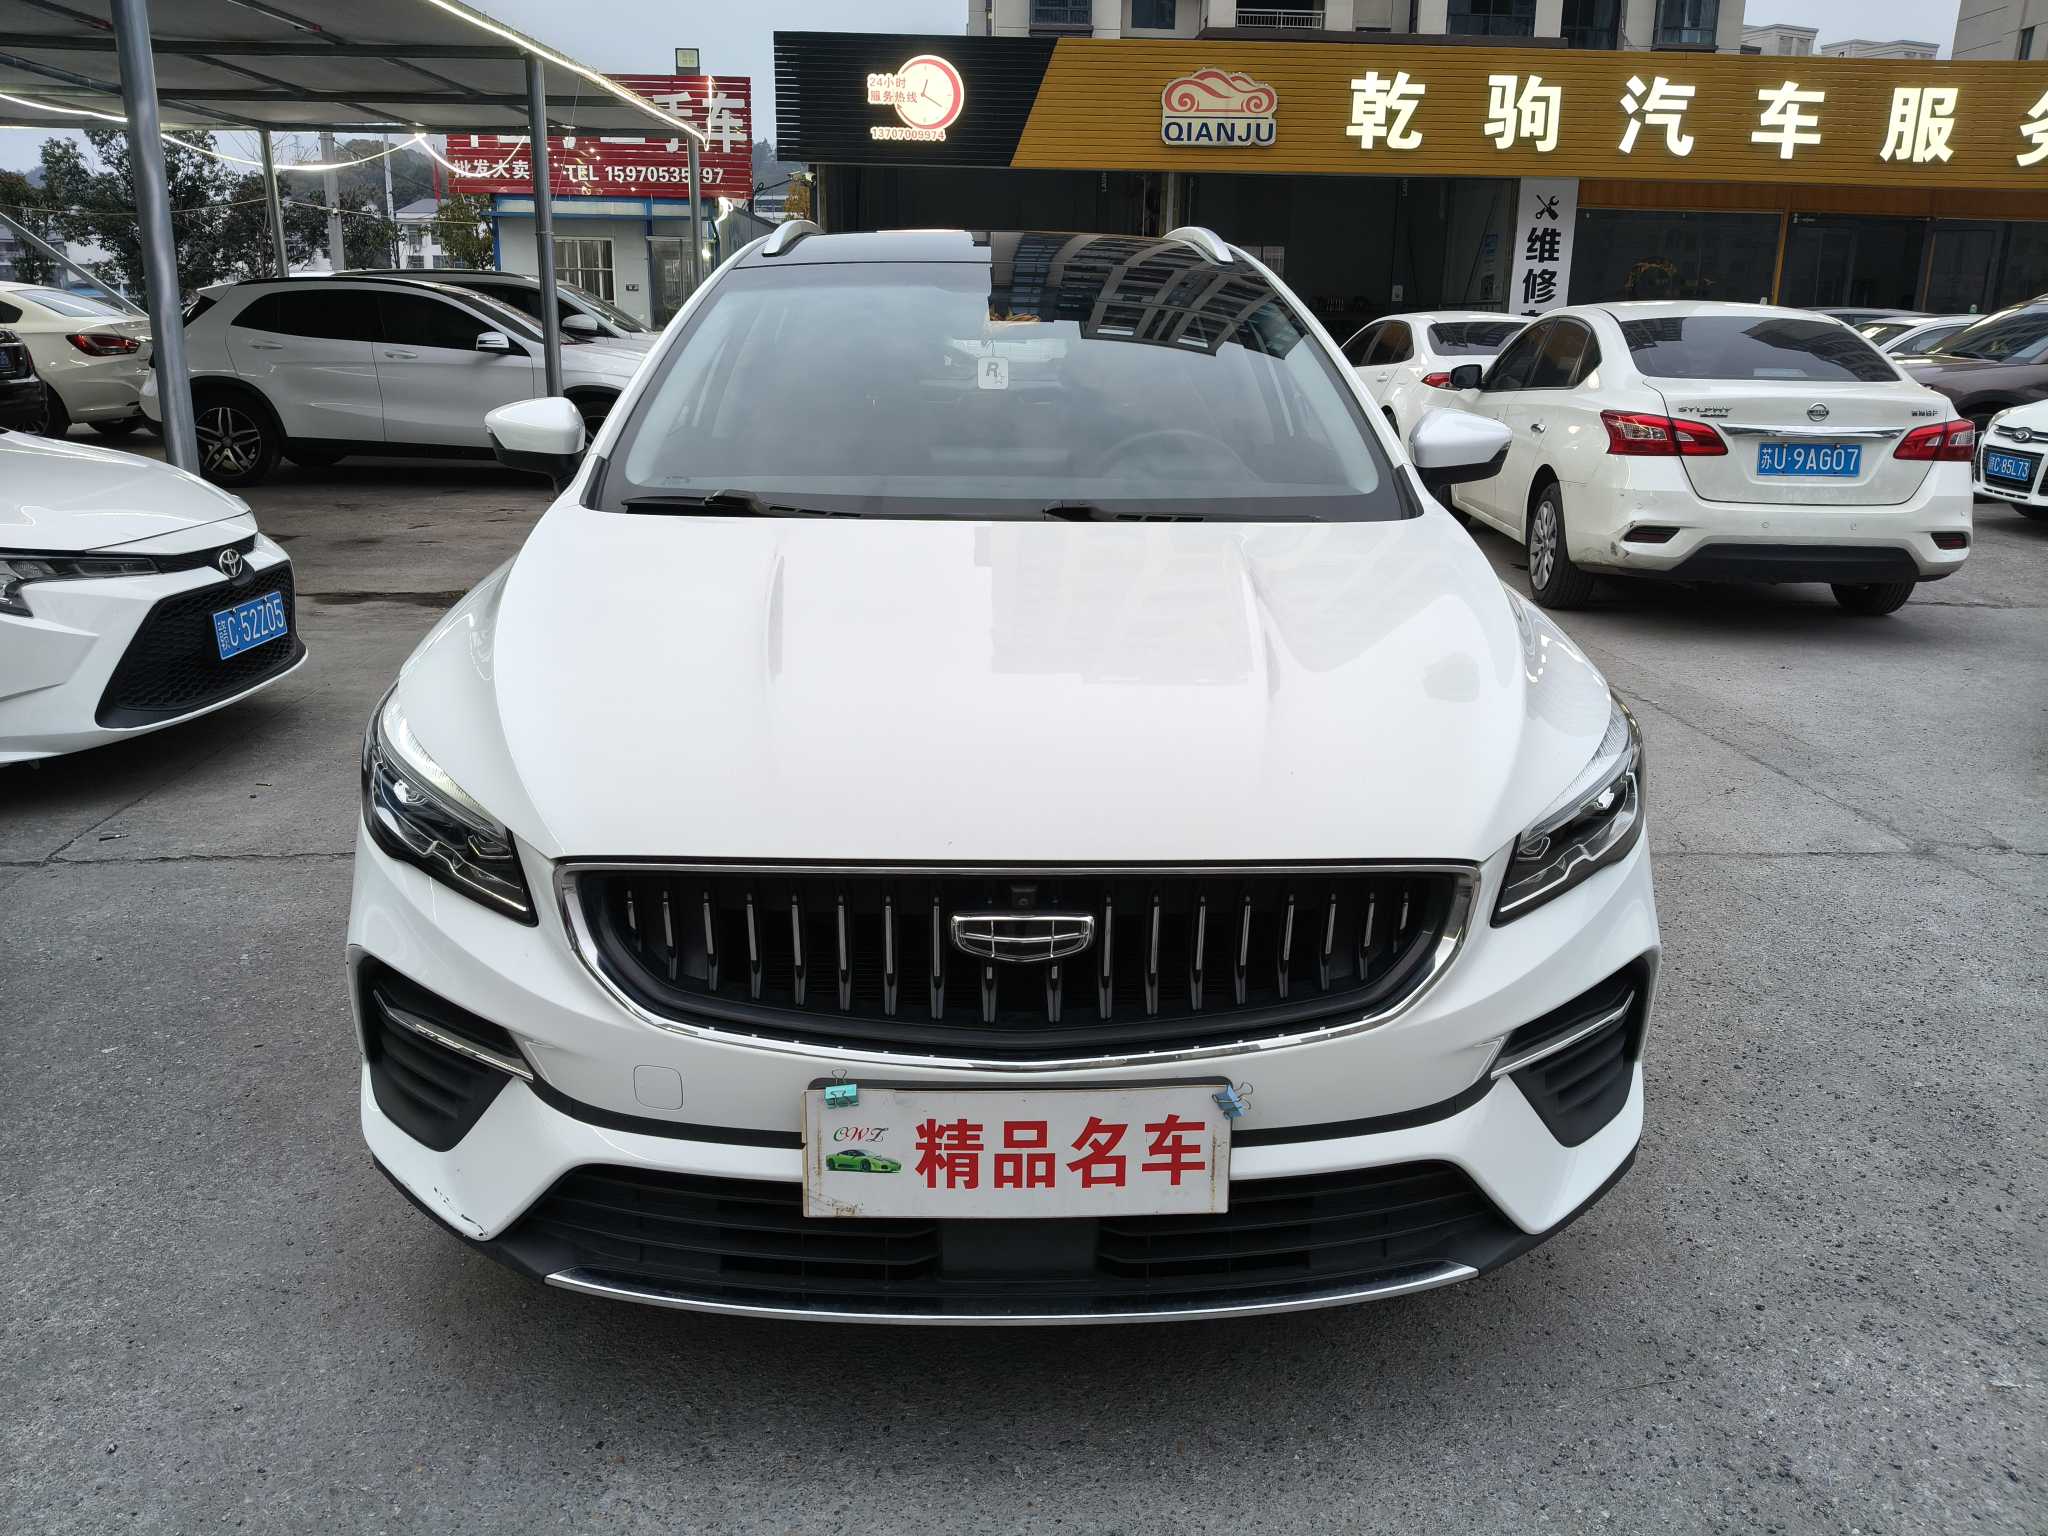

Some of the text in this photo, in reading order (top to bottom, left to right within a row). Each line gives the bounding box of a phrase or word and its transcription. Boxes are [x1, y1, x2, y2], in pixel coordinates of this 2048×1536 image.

[869, 76, 906, 89] 24小时
[870, 90, 918, 103] 服务热线
[1164, 121, 1274, 143] QIANJU
[565, 164, 724, 184] TEL 1597053597
[1521, 227, 1562, 317] 维修
[915, 1114, 1206, 1189] 精品名车
